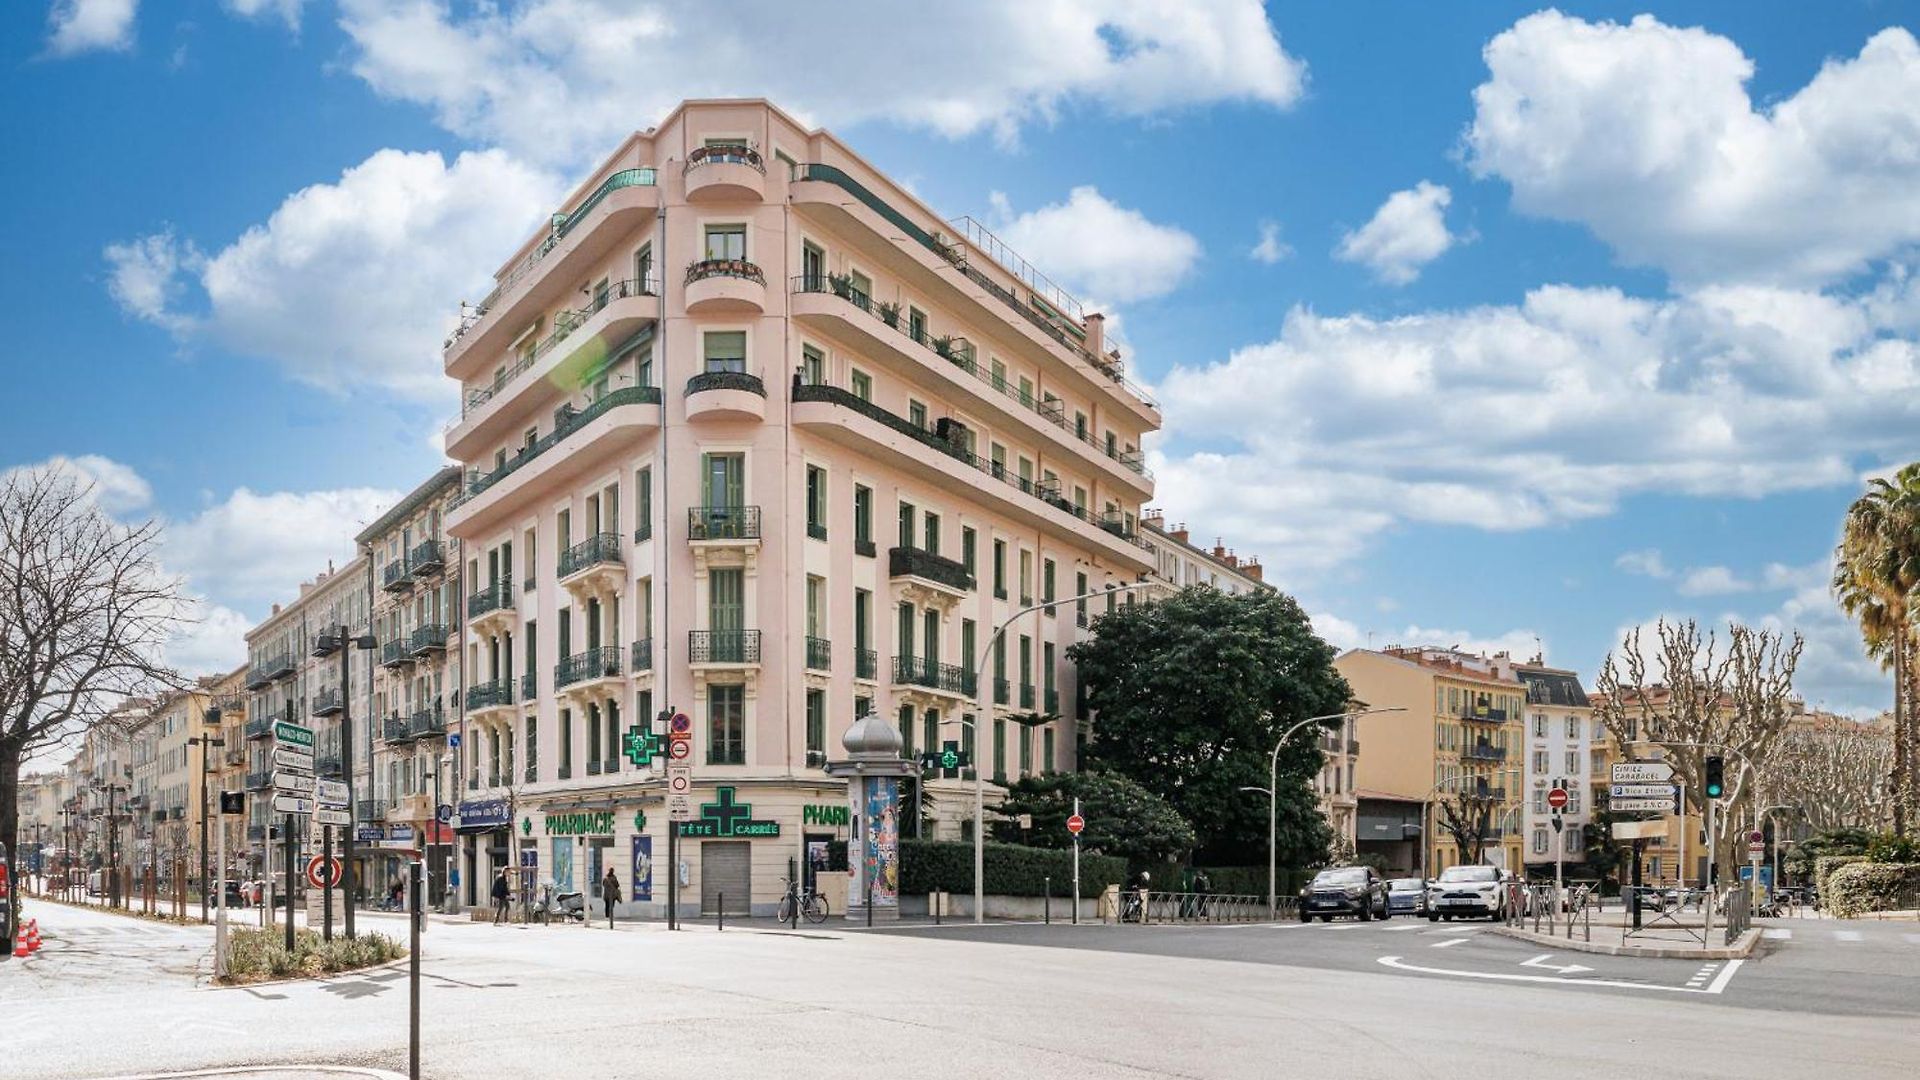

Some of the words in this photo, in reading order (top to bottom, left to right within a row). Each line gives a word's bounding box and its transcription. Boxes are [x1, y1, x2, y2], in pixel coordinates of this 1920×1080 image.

[545, 812, 615, 835] PHARMACIE
[680, 823, 712, 834] TÊTE
[735, 823, 779, 834] CARRÉE
